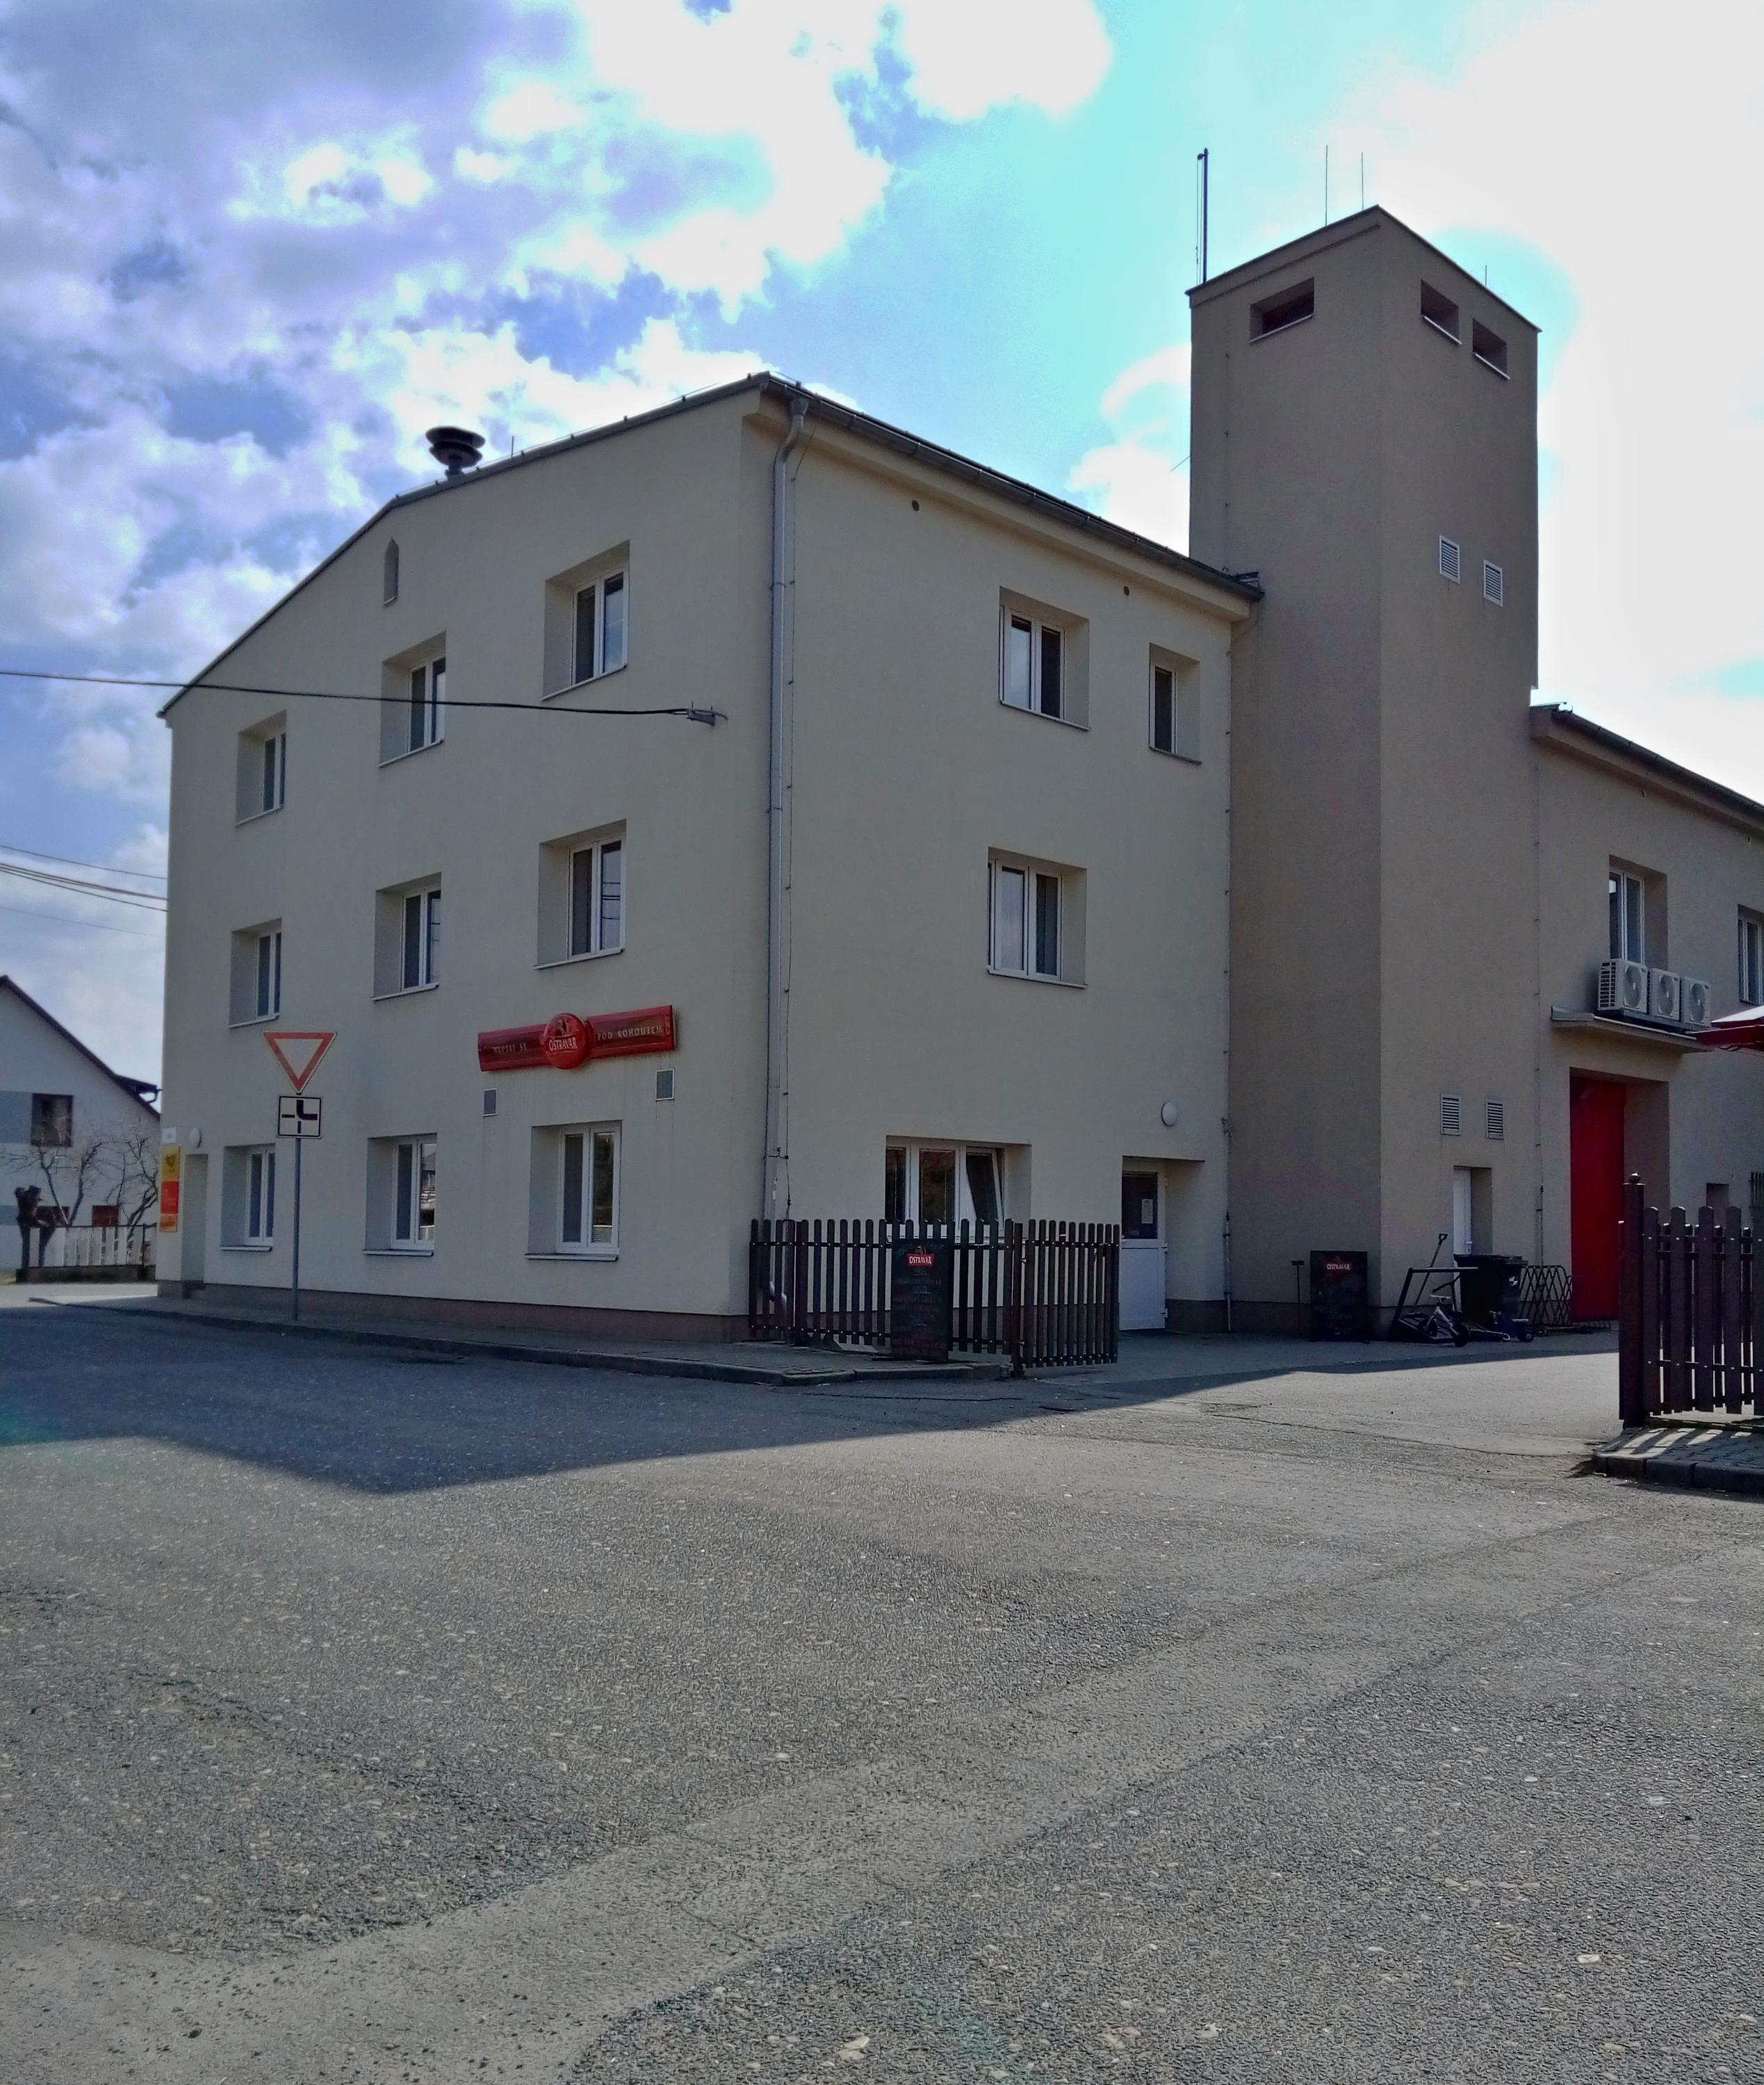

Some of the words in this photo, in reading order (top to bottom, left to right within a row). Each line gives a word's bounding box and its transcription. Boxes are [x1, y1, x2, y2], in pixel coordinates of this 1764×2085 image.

[597, 1031, 612, 1041] POD
[548, 1036, 578, 1052] OSTRAVAR
[909, 1256, 932, 1264] OSTRAVAR
